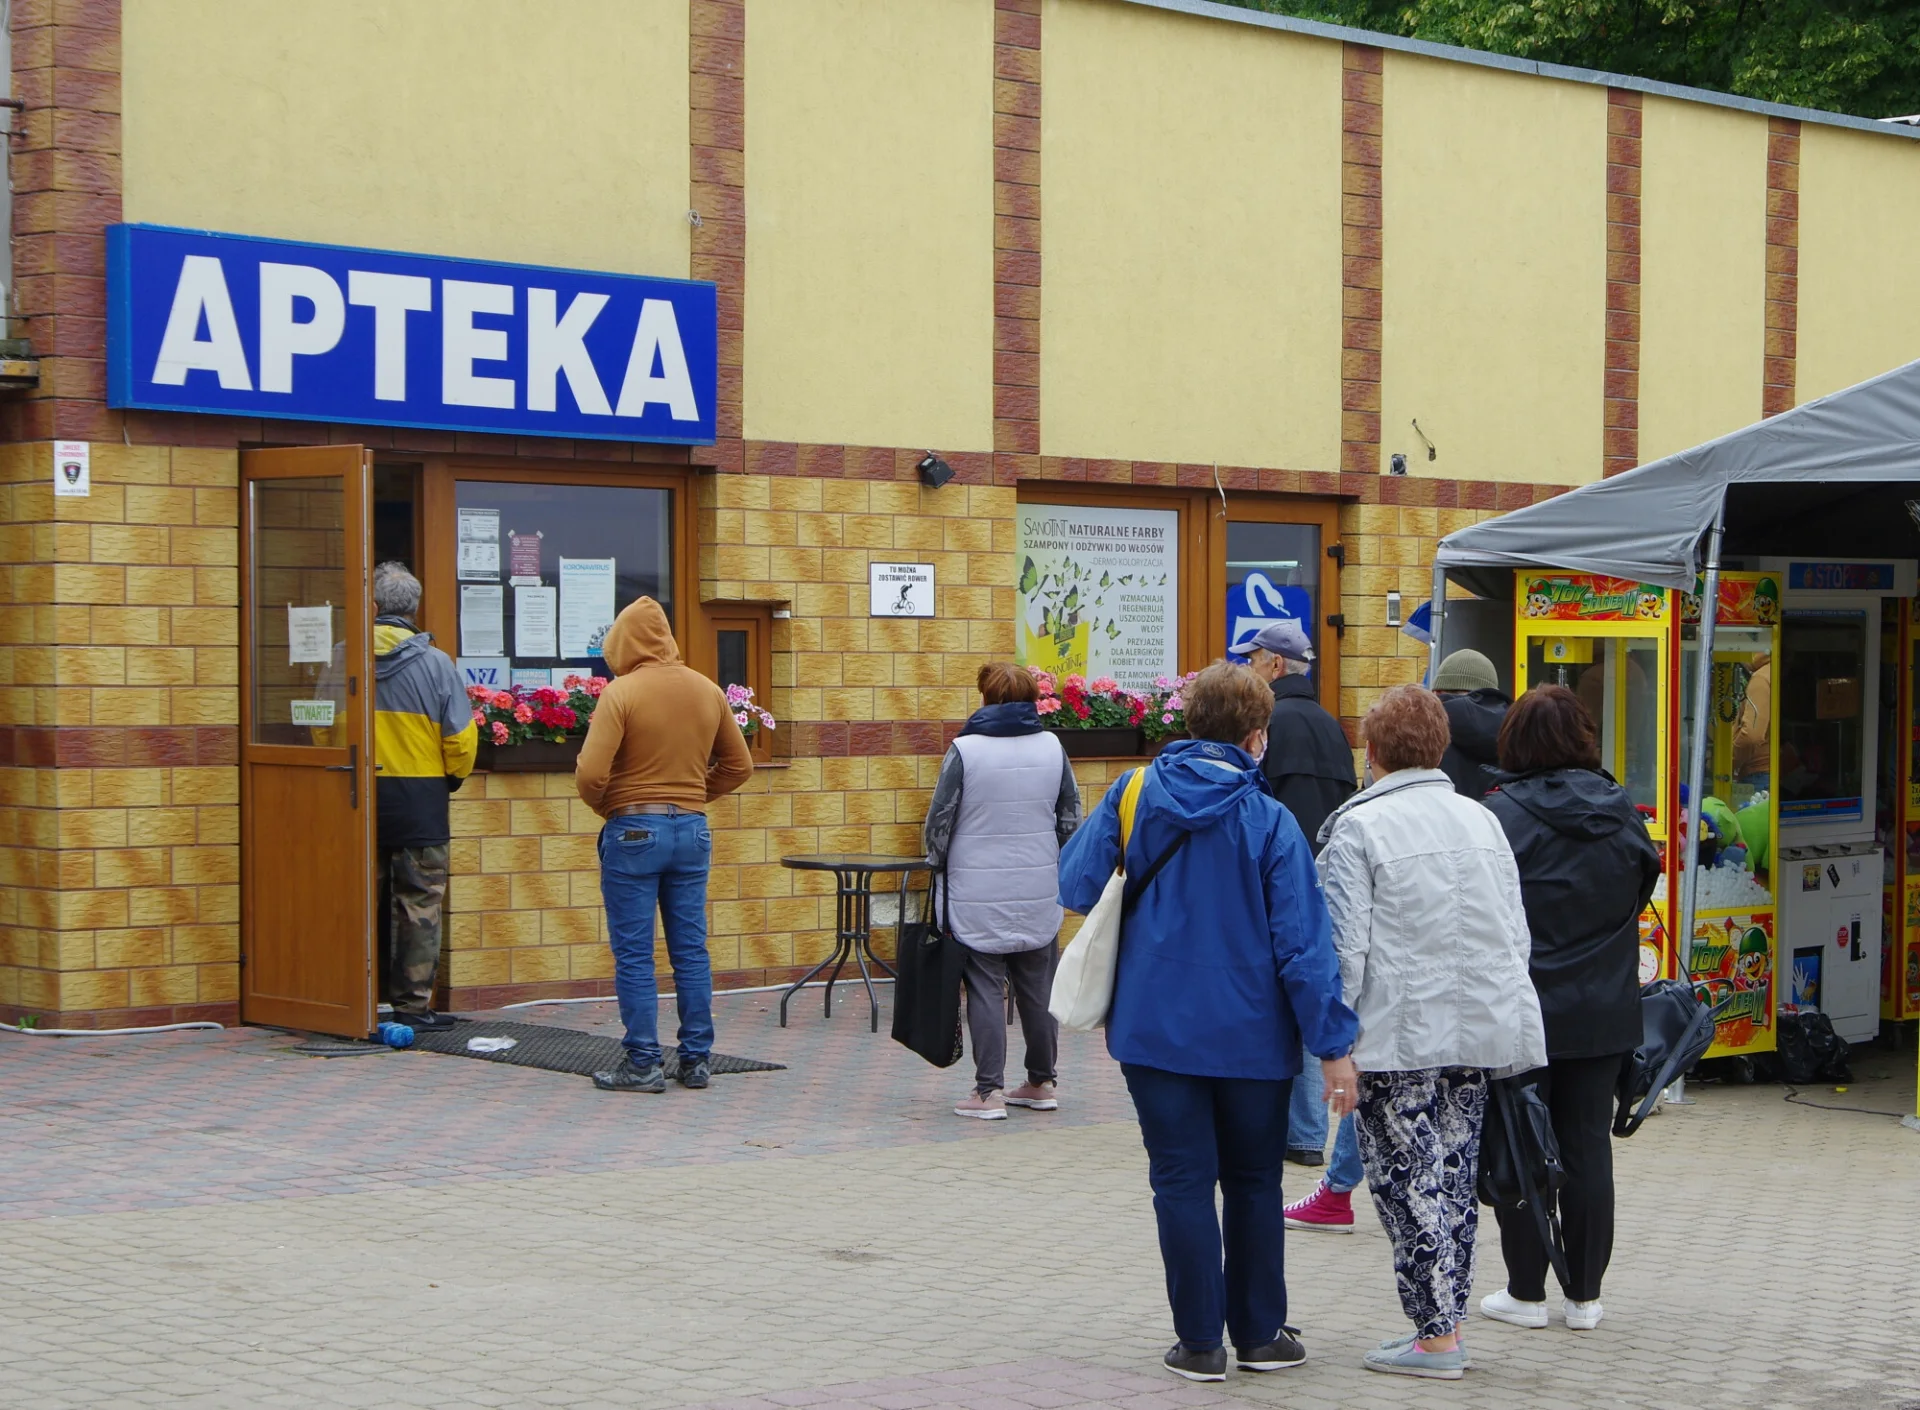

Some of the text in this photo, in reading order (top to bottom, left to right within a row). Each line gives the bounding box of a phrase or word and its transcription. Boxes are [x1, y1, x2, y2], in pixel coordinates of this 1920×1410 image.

[151, 254, 700, 422] APTEKA
[1069, 524, 1129, 537] NATURALNE
[1132, 527, 1165, 538] FARBY
[1023, 540, 1069, 551] SZAMPONY
[1075, 541, 1113, 552] ODŻYWKI
[1115, 544, 1127, 552] DO
[1128, 543, 1165, 553] WŁOSÓW
[1093, 557, 1164, 567] DERMO KOLORYZACJA
[898, 565, 917, 573] MOŻNA
[1120, 595, 1164, 604] WZMACNIAJĄ
[1551, 578, 1592, 603] TOY
[1579, 593, 1623, 615] SOLDIER
[1122, 605, 1164, 614] REGENERUJĄ
[1127, 638, 1164, 646] PRZYJAZNE
[1111, 647, 1164, 656] DLA ALERGIKÓW
[1112, 658, 1135, 666] KOBIET
[1137, 658, 1143, 666] W
[465, 668, 498, 684] NFZ
[1114, 671, 1127, 679] BEZ
[293, 705, 333, 720] OTWARTE
[1690, 937, 1731, 973] TOY
